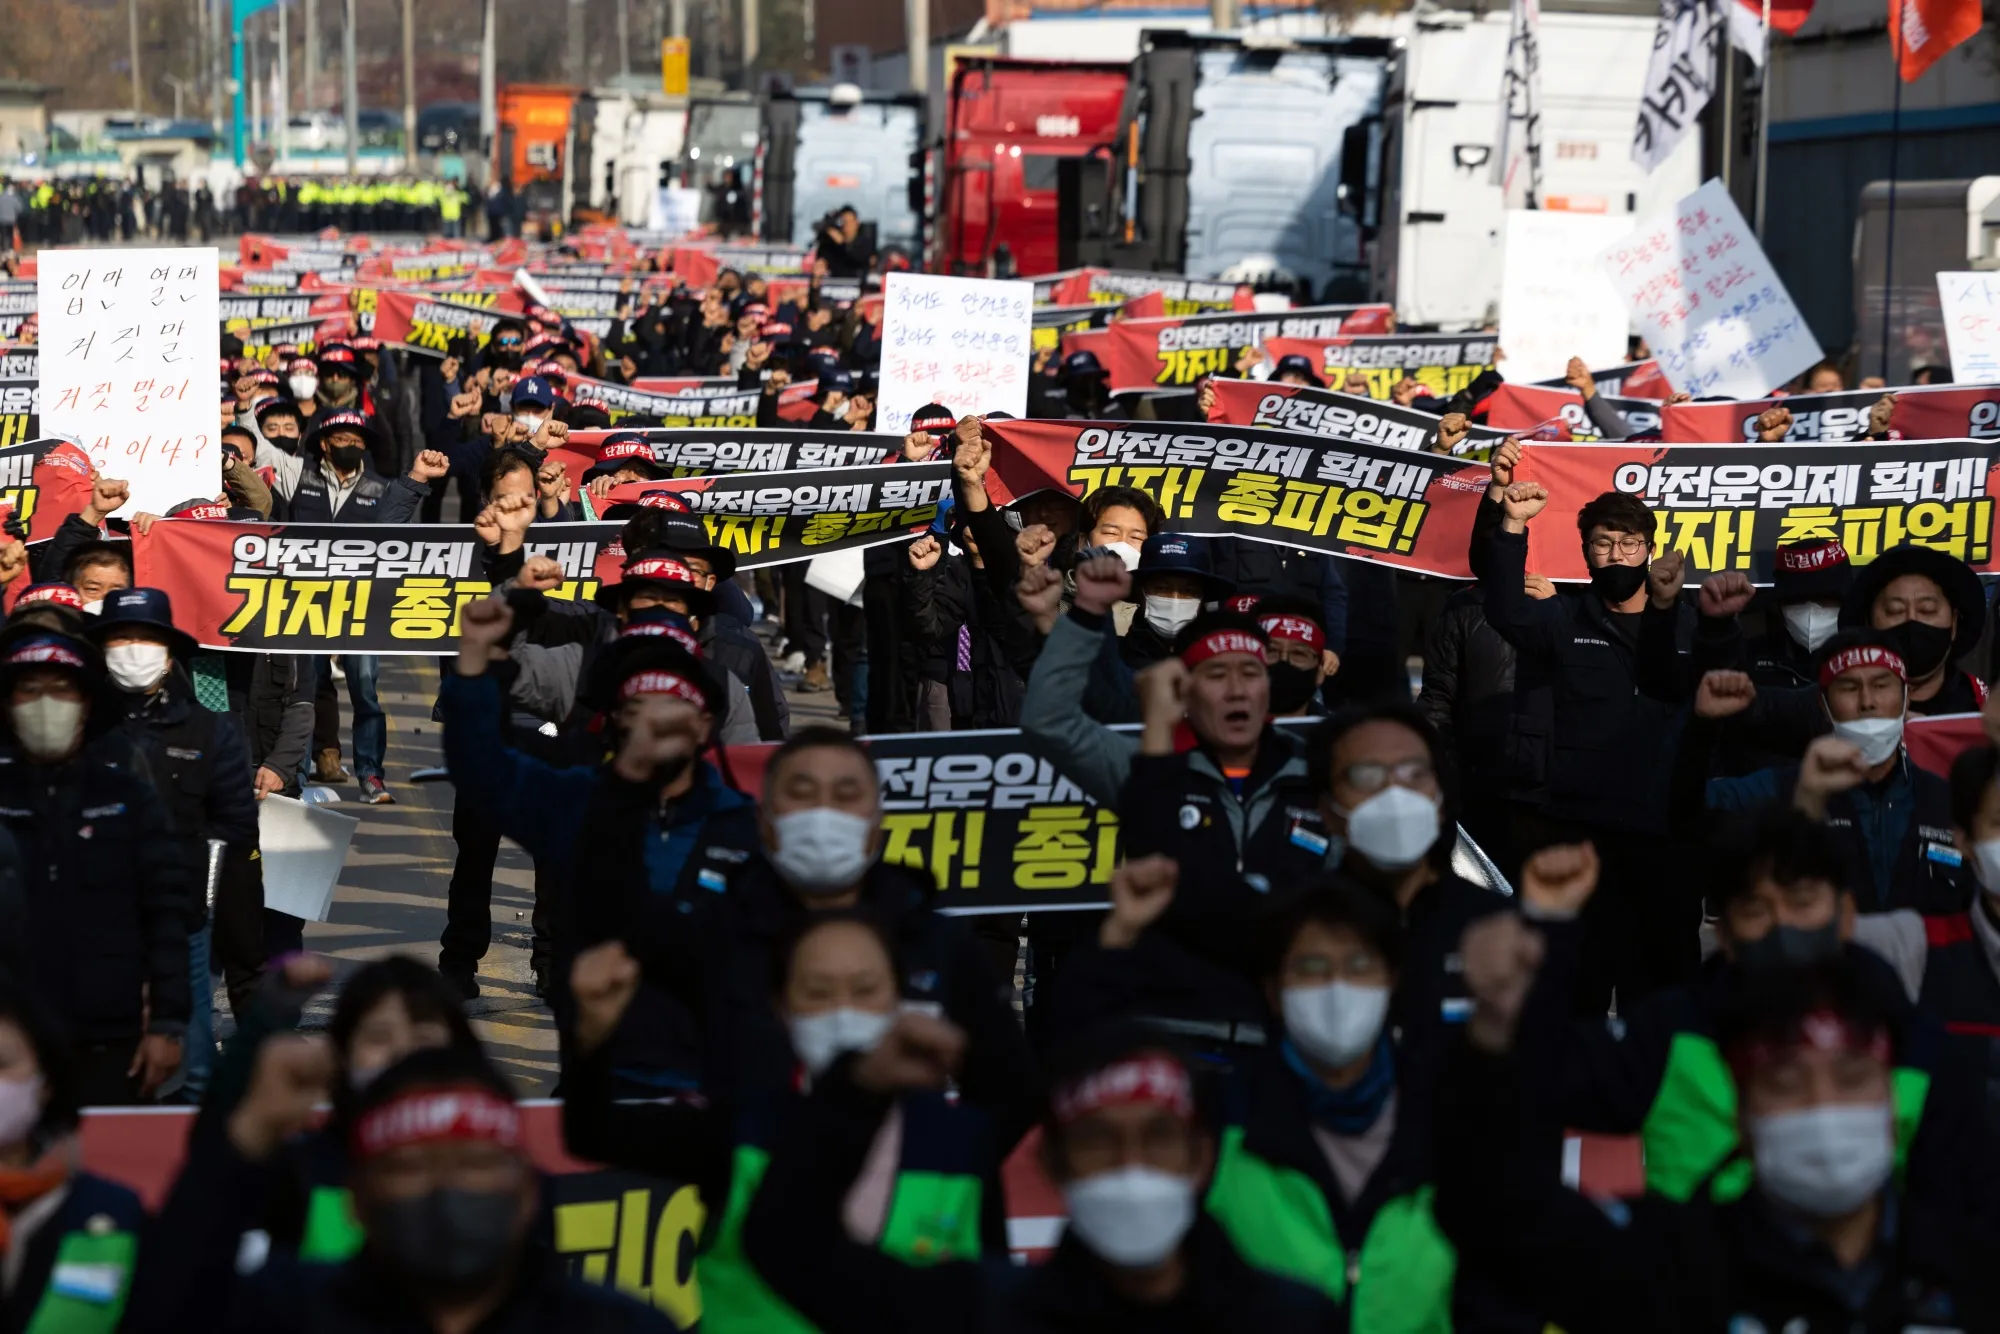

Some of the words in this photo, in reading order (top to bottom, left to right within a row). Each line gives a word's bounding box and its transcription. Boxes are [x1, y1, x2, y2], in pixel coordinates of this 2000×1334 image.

[62, 266, 124, 316] 입만
[150, 264, 199, 307] 열면
[53, 377, 191, 412] 거짓말이
[1257, 393, 1428, 451] 안전운임제
[75, 433, 208, 469] 상이냐?
[650, 441, 793, 472] 전운임제
[1074, 427, 1314, 478] 안전운임제
[1315, 450, 1434, 501] 확대!
[680, 482, 874, 517] 안전운임제
[879, 478, 954, 508] 확대
[1613, 463, 1862, 509] 안전운임제
[1869, 456, 1989, 503] 확대!
[1216, 471, 1431, 553] 종파업!
[233, 534, 475, 578] 안전운임제
[1784, 552, 1811, 570] 단결
[223, 577, 366, 639] 가자!
[881, 811, 986, 891] 자!
